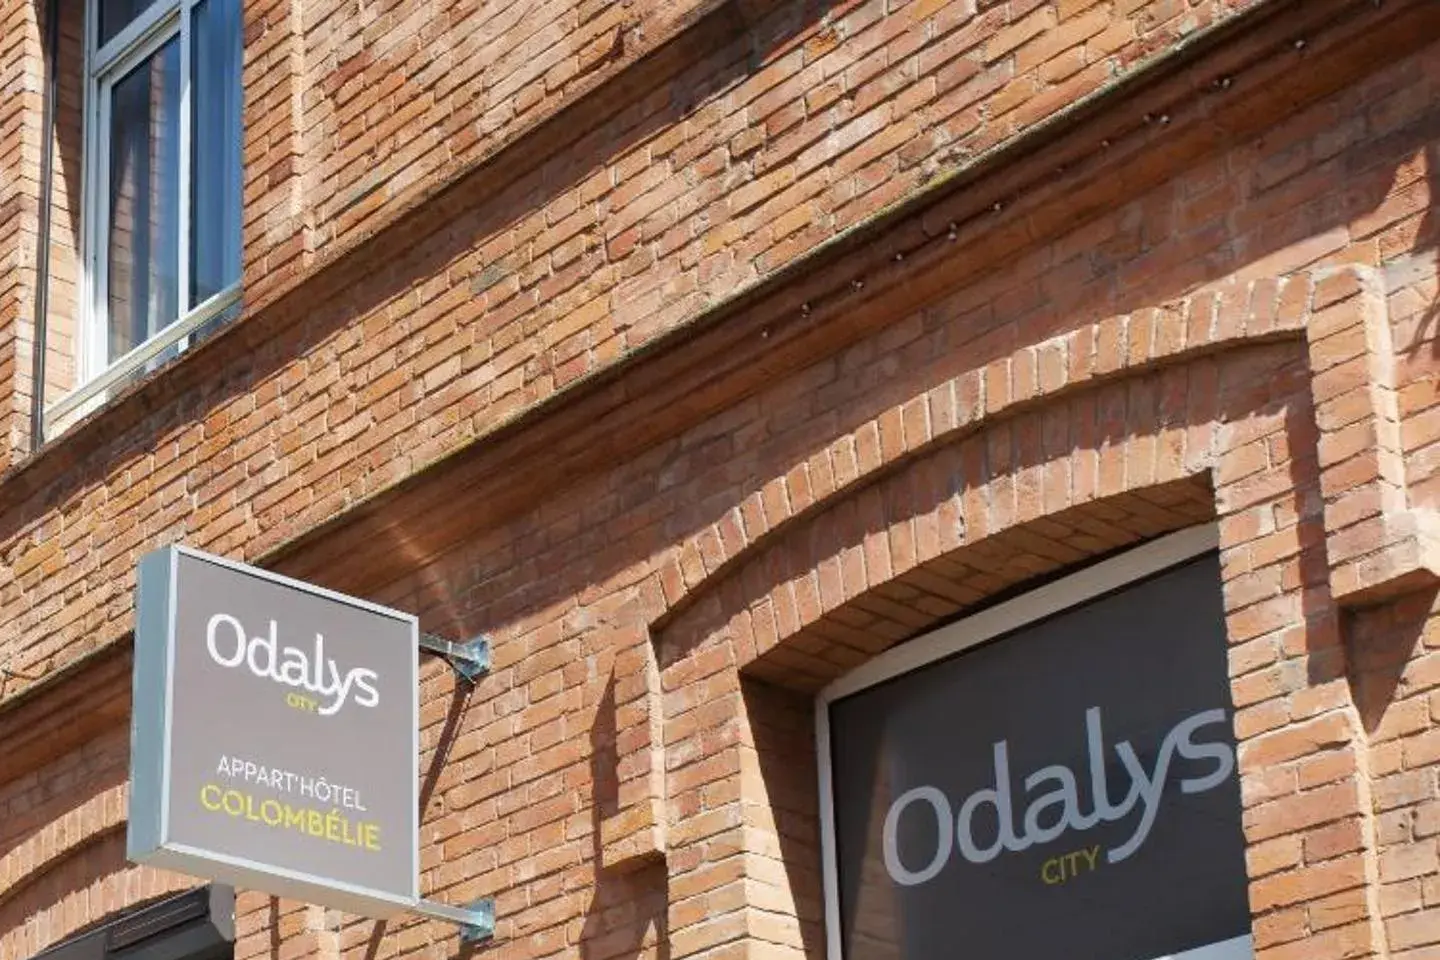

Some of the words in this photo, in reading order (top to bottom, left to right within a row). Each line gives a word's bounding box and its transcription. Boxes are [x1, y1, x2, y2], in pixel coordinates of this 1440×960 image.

[206, 613, 380, 715] Odalys
[216, 755, 368, 811] APPART'HÔTEL
[882, 705, 1234, 886] Odalys
[200, 784, 382, 850] COLOMBÉLIE
[1041, 845, 1101, 885] CITY
